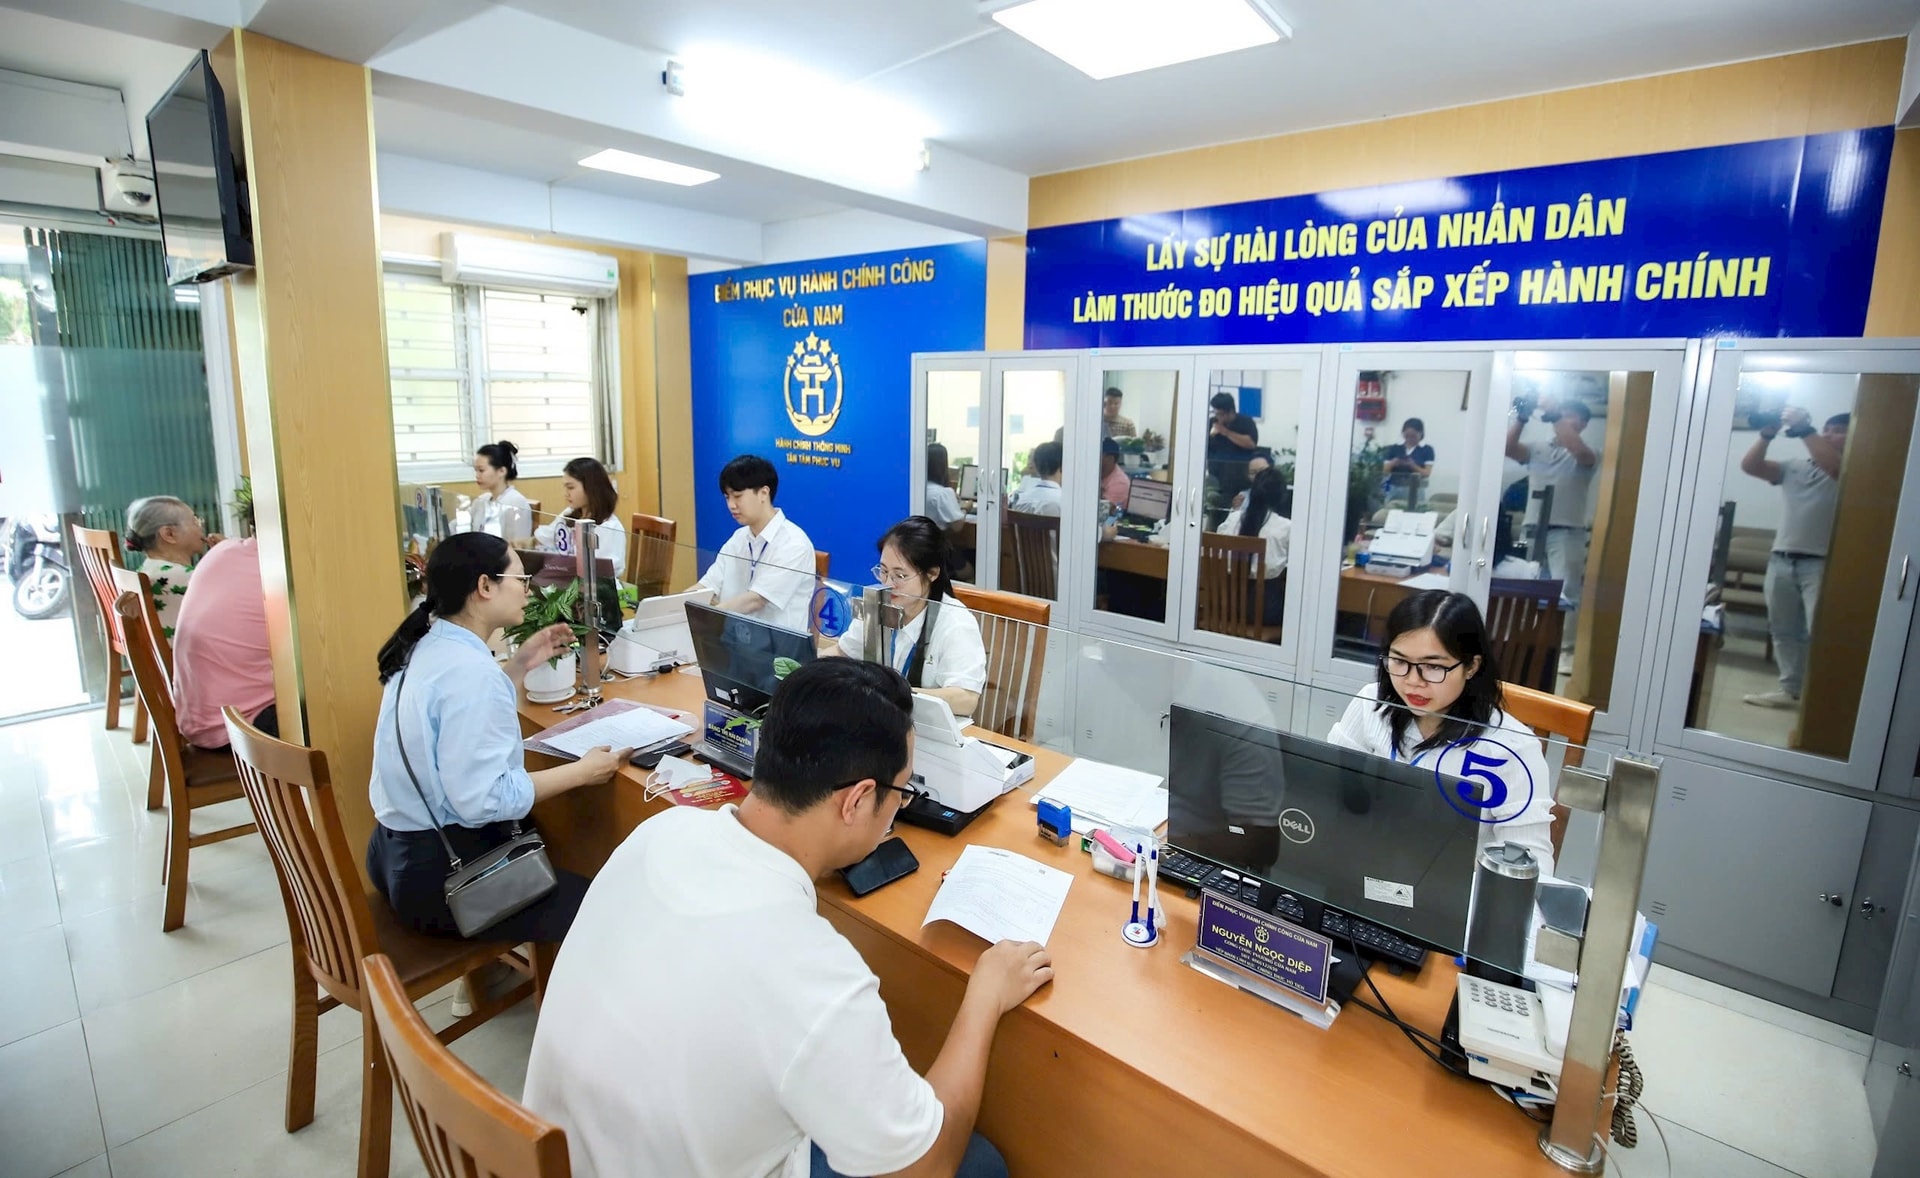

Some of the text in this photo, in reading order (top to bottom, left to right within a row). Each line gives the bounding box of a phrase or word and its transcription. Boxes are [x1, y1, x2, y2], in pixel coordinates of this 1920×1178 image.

[1146, 193, 1627, 272] LẤY SỰ HÀI LÒNG CỦA NHÂN DÂN
[744, 278, 775, 302] PHỤC
[778, 275, 797, 299] VỤ
[800, 269, 838, 294] HÀNH
[842, 262, 886, 289] CHÍNH
[890, 256, 935, 284] CÔNG
[1073, 252, 1771, 323] LÀM THƯỚC ĐO HIỆU QUẢ SẮP XẾP HÀNH CHÍNH
[783, 302, 843, 328] CỬA NAM
[558, 528, 568, 552] 3
[818, 597, 839, 631] 4
[1455, 749, 1509, 809] 5
[1282, 817, 1311, 835] DELL
[1211, 924, 1312, 973] NGUYỄN NGỌC DIỆP
[1277, 927, 1293, 938] CÔNG
[1305, 939, 1318, 948] NAM
